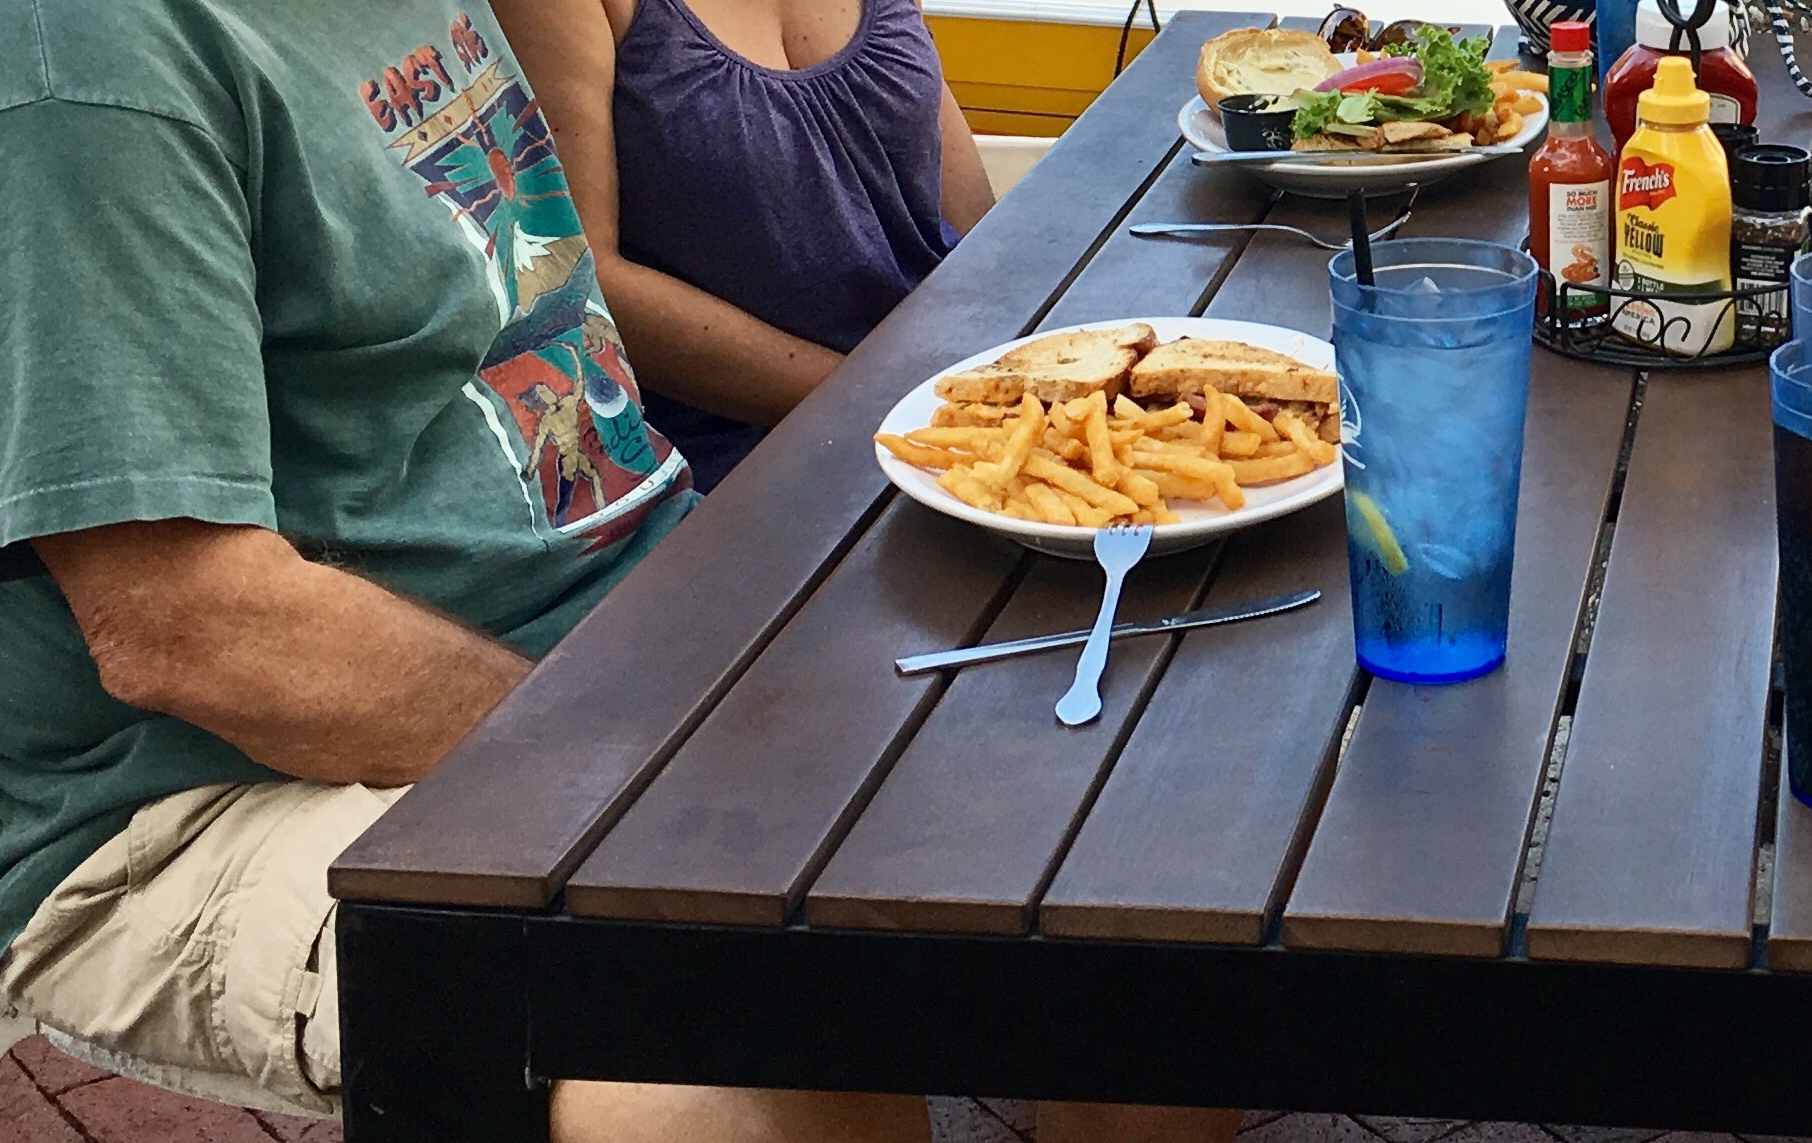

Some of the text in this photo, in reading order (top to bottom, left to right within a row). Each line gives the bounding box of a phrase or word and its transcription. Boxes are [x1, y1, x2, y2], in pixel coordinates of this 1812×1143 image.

[358, 45, 455, 133] EAST
[1622, 167, 1670, 195] French's
[1566, 196, 1597, 206] MORE
[1624, 222, 1665, 259] YELLOW
